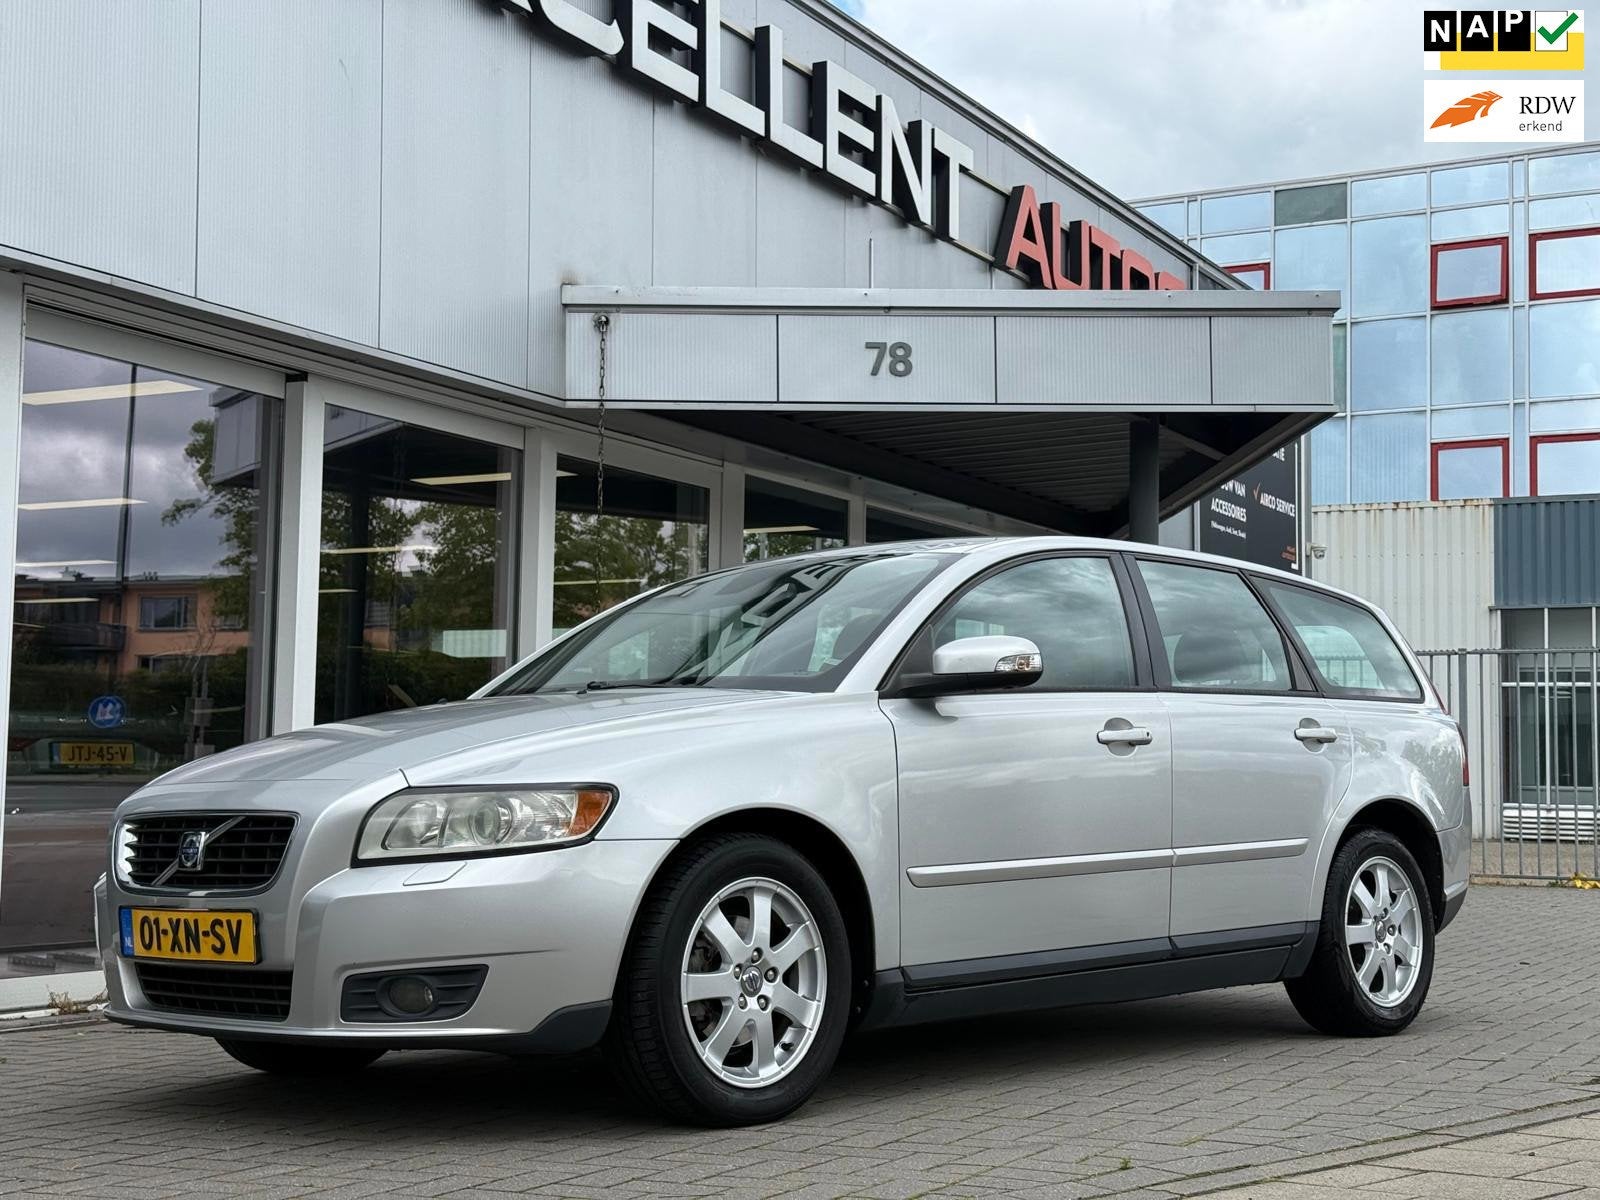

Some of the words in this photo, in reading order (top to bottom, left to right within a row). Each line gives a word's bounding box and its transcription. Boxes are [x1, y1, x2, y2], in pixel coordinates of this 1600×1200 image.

[508, 0, 973, 240] ELLENT
[1002, 184, 1186, 290] AUTO
[865, 341, 914, 377] 78
[1210, 497, 1247, 523] ACCESSOIRES
[1276, 497, 1296, 518] SERVICE
[68, 745, 128, 762] JTJ-45-V
[139, 915, 242, 955] 01-XN-SV
